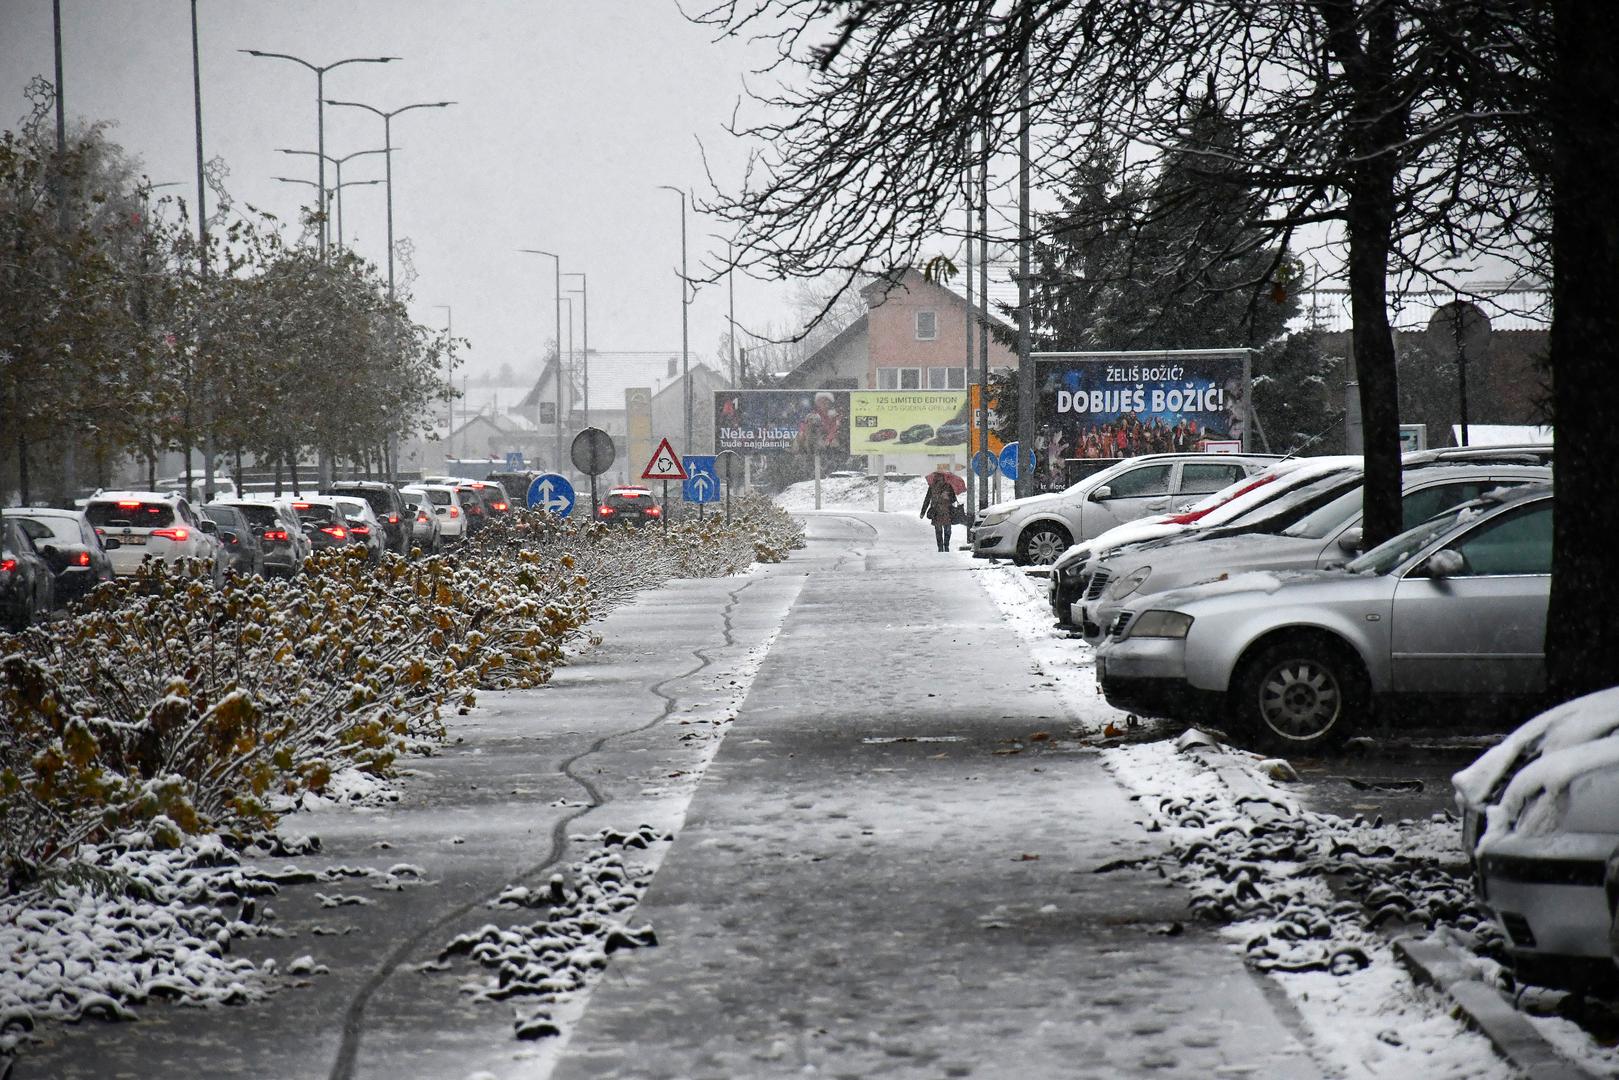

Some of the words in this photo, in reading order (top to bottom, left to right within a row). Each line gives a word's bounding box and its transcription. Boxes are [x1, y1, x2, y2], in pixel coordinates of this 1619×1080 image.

[1107, 365, 1139, 382] ŽELIŠ
[1142, 364, 1184, 381] BOŽIĆ?
[1057, 383, 1145, 414] DOBIJEŠ
[1151, 382, 1224, 413] BOŽIĆ!
[720, 427, 755, 439] Neka
[758, 427, 799, 443] ljubav
[721, 440, 742, 448] bude
